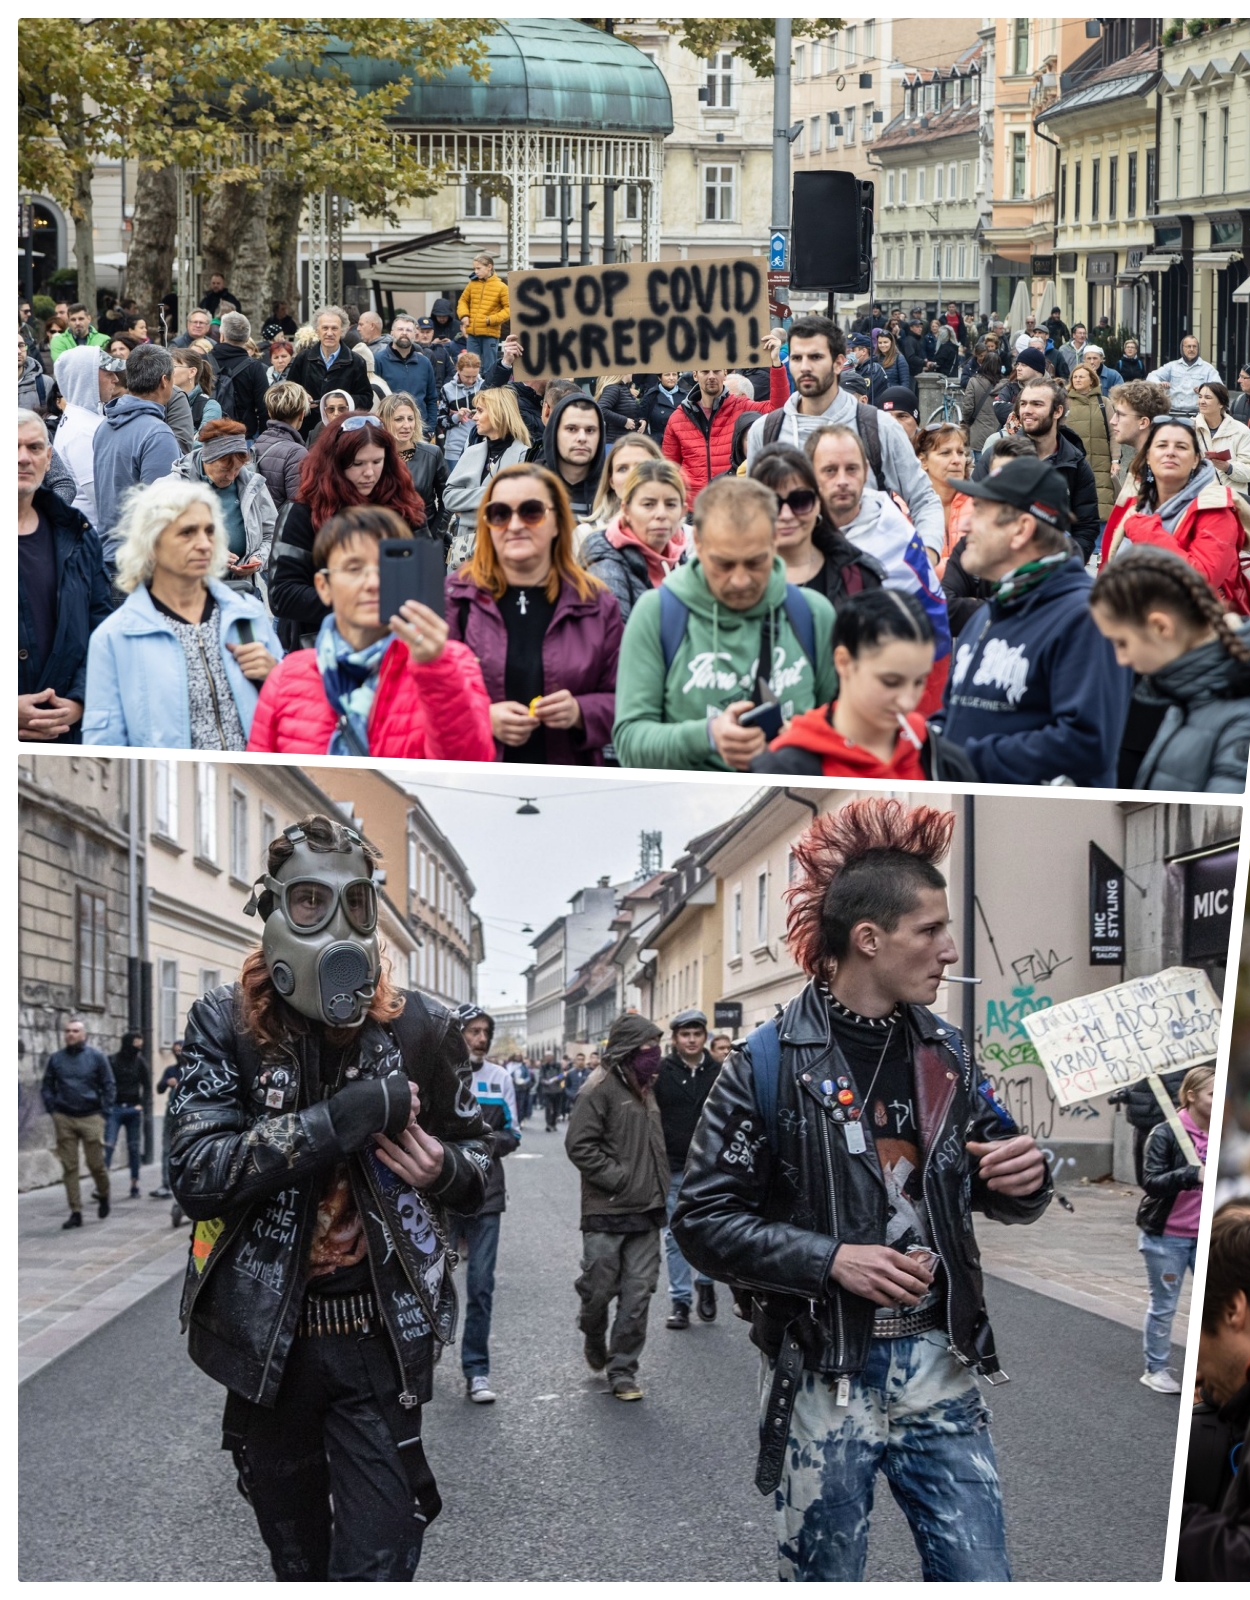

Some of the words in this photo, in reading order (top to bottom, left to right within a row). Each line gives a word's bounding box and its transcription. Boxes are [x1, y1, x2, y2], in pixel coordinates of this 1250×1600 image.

[516, 270, 630, 327] STOP
[648, 260, 761, 317] COVID
[519, 315, 760, 377] UKREPOM!
[1106, 879, 1119, 938] STYLING
[1194, 888, 1229, 920] MIC
[1094, 912, 1106, 938] MIC
[1058, 1067, 1098, 1101] PCT
[276, 1187, 300, 1209] AT
[266, 1207, 296, 1227] THE
